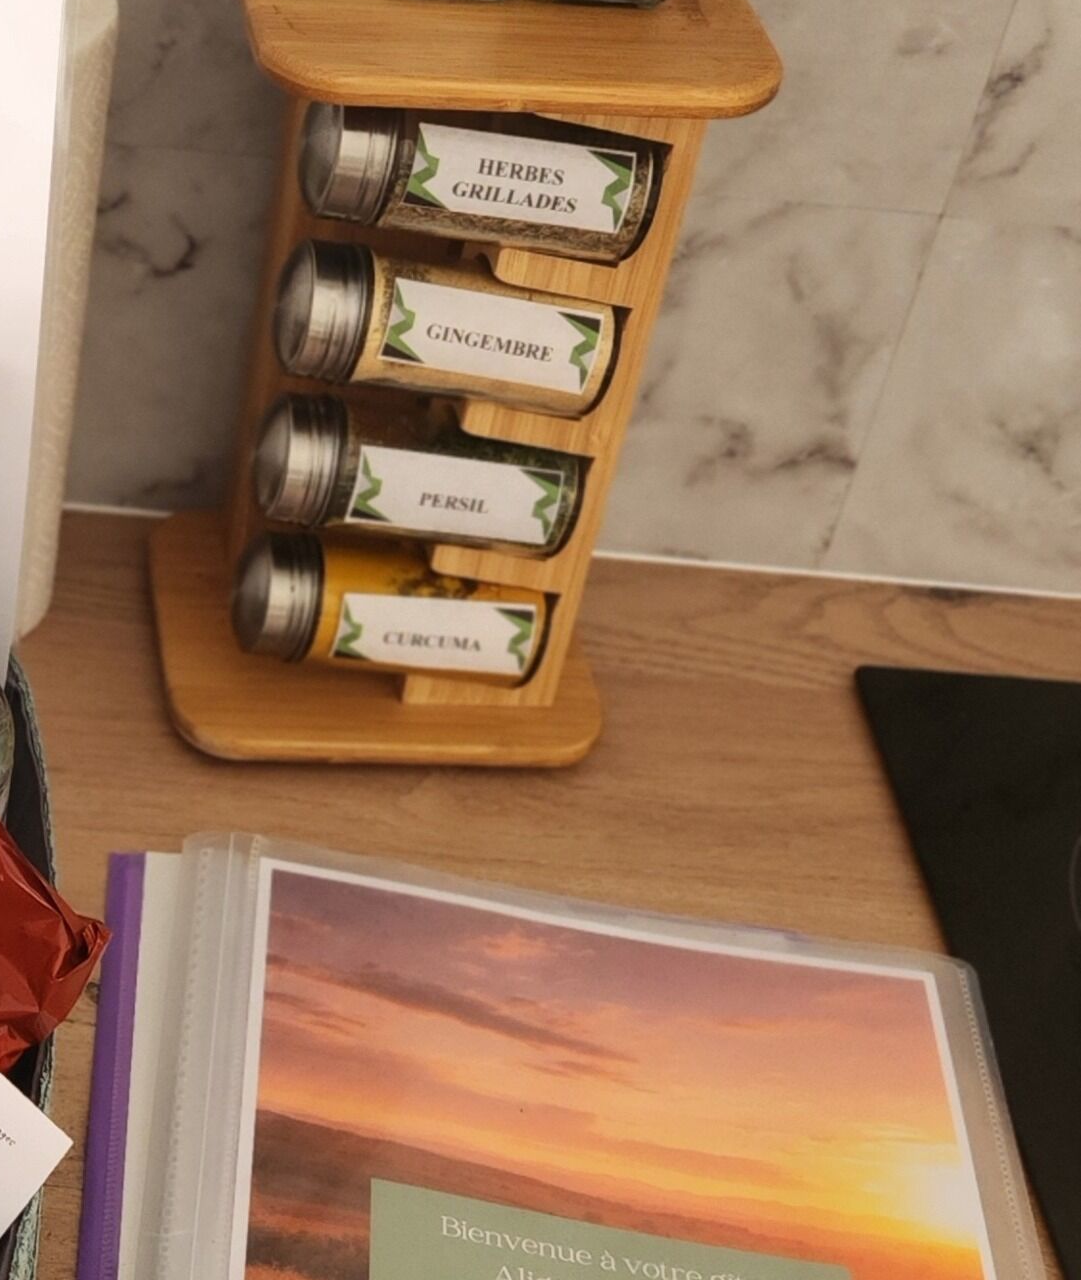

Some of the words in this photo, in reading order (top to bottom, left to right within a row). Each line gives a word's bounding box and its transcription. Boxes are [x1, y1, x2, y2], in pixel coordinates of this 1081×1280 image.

[477, 157, 565, 187] HERBES
[451, 180, 578, 214] GRILLADES
[426, 322, 554, 363] GINGEMBRE
[419, 491, 489, 515] PERSIL
[382, 629, 482, 653] CURCUMA
[440, 1215, 593, 1266] Bienvenue
[600, 1249, 618, 1272] à
